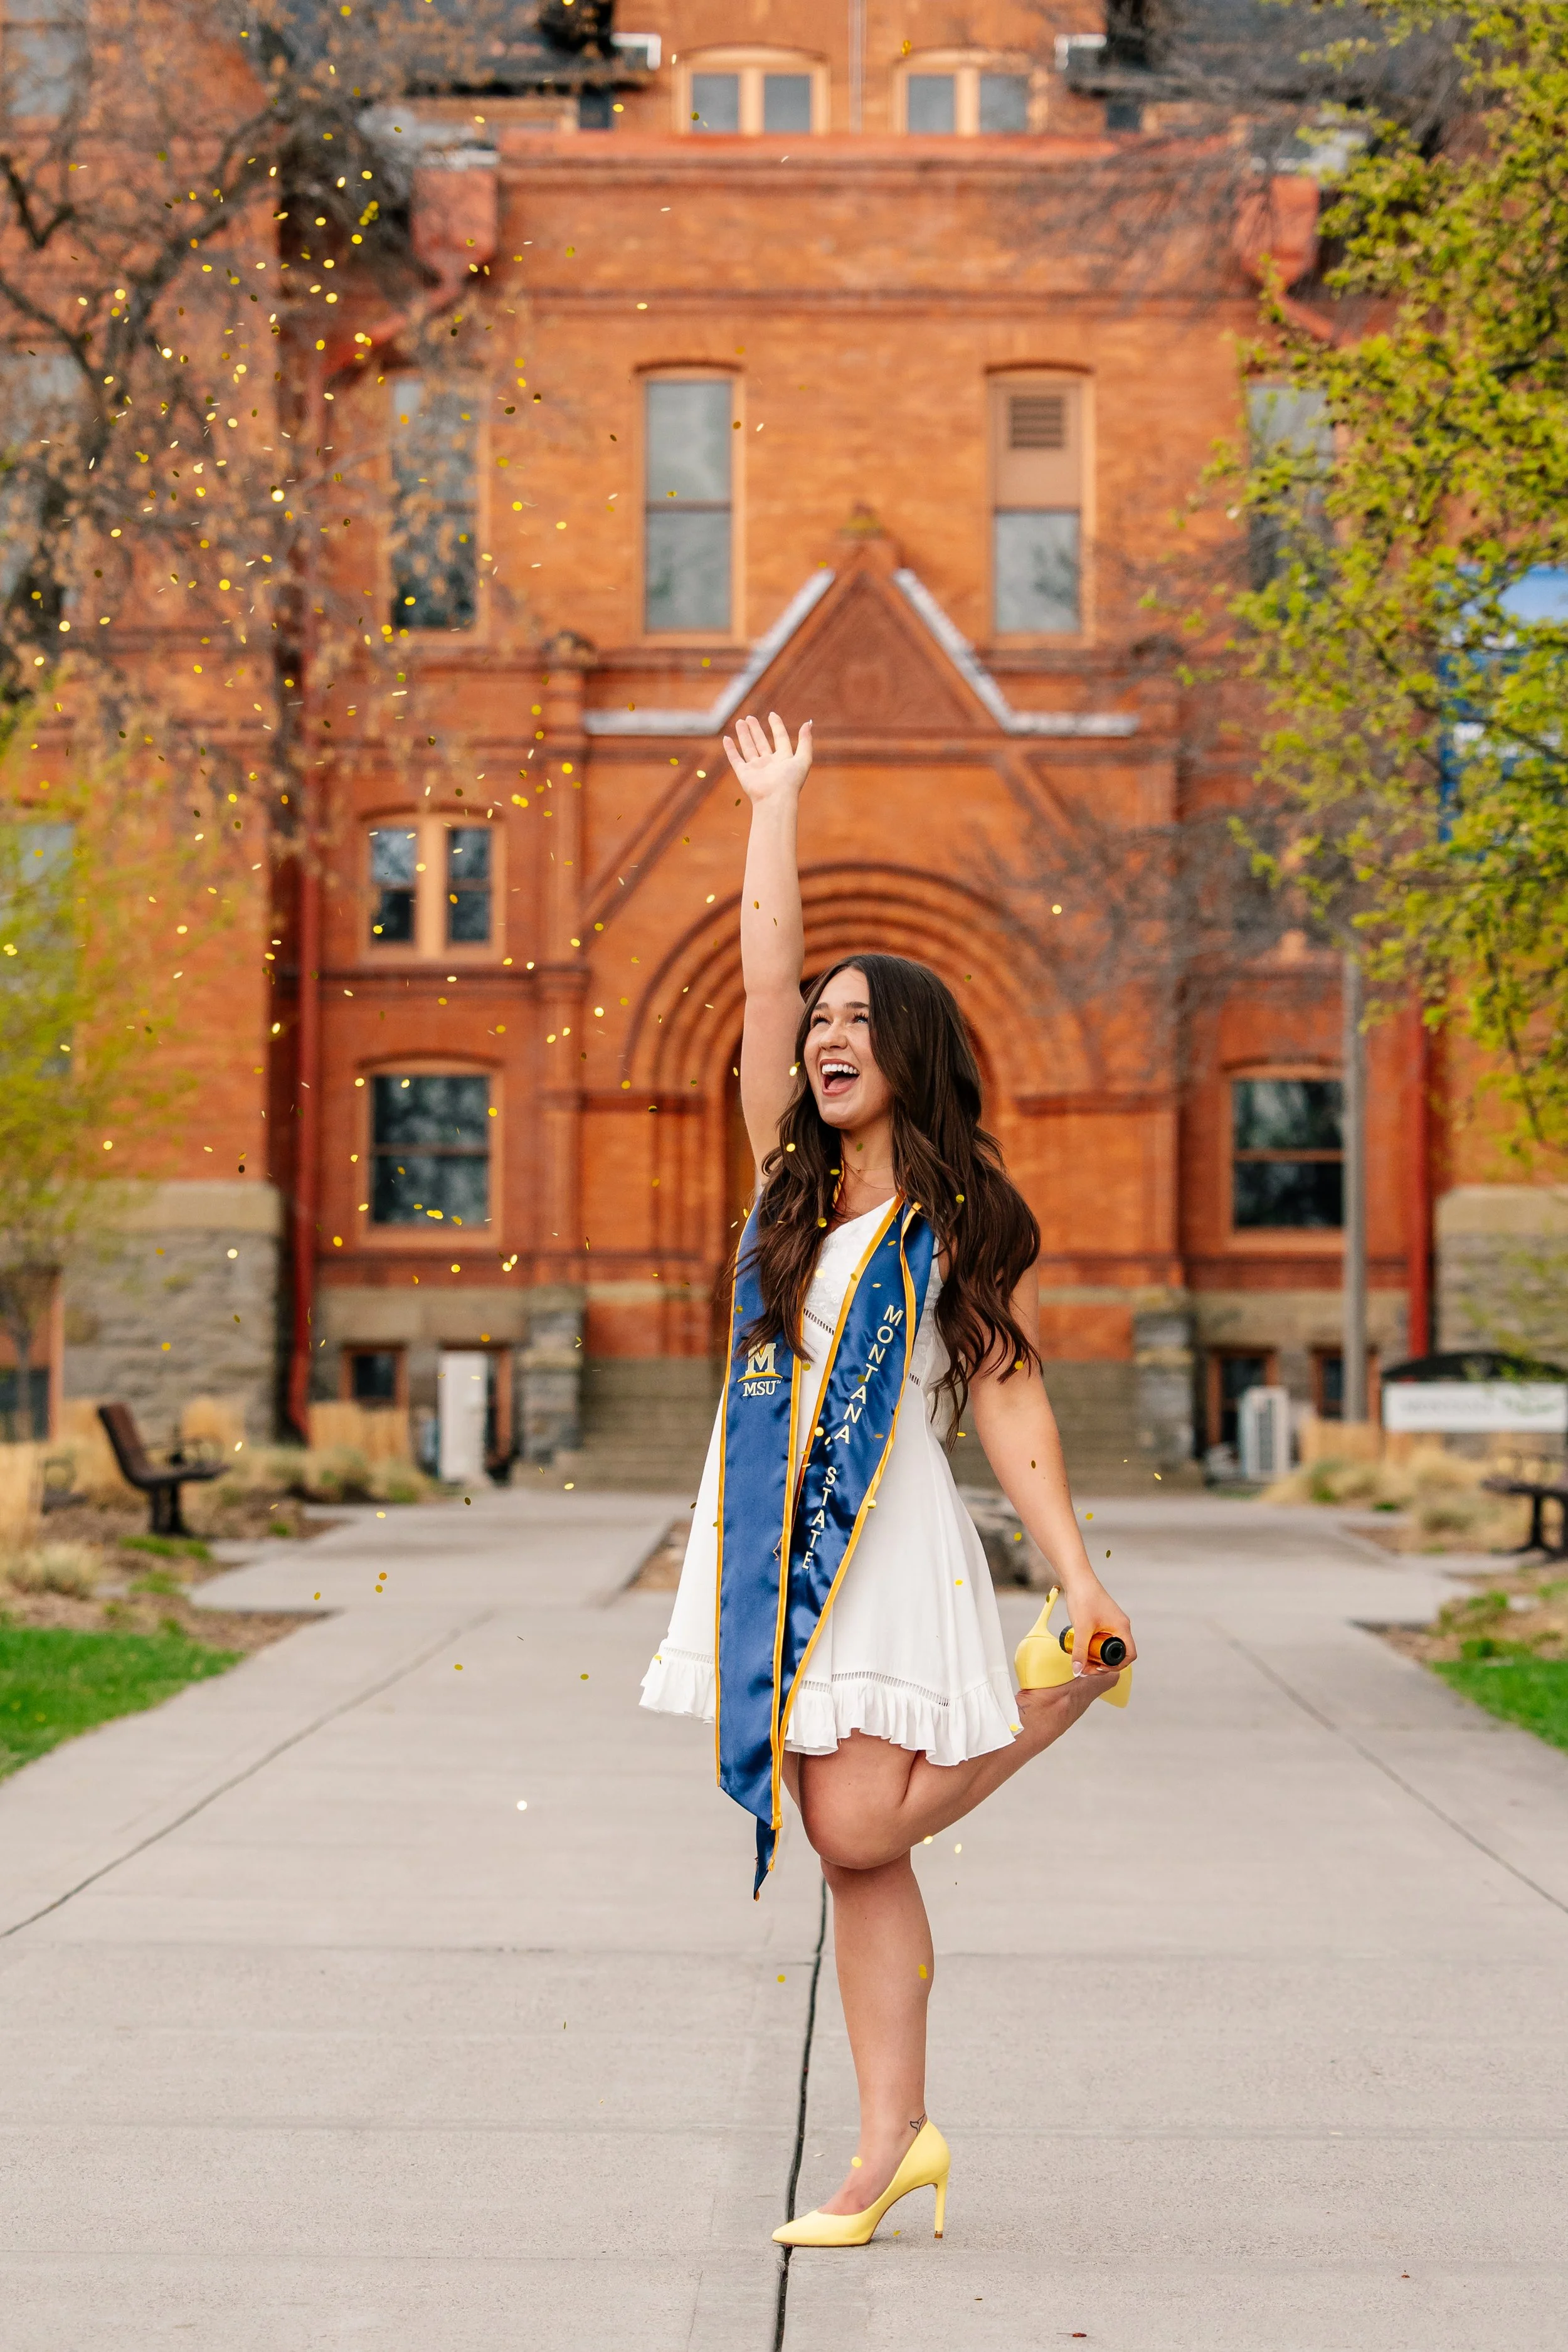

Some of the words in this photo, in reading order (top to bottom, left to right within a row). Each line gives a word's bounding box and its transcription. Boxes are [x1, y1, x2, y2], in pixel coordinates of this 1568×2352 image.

[743, 1380, 777, 1397] MSU
[745, 1342, 776, 1376] M
[834, 1305, 904, 1444] MONTANA
[802, 1466, 837, 1570] STATE
